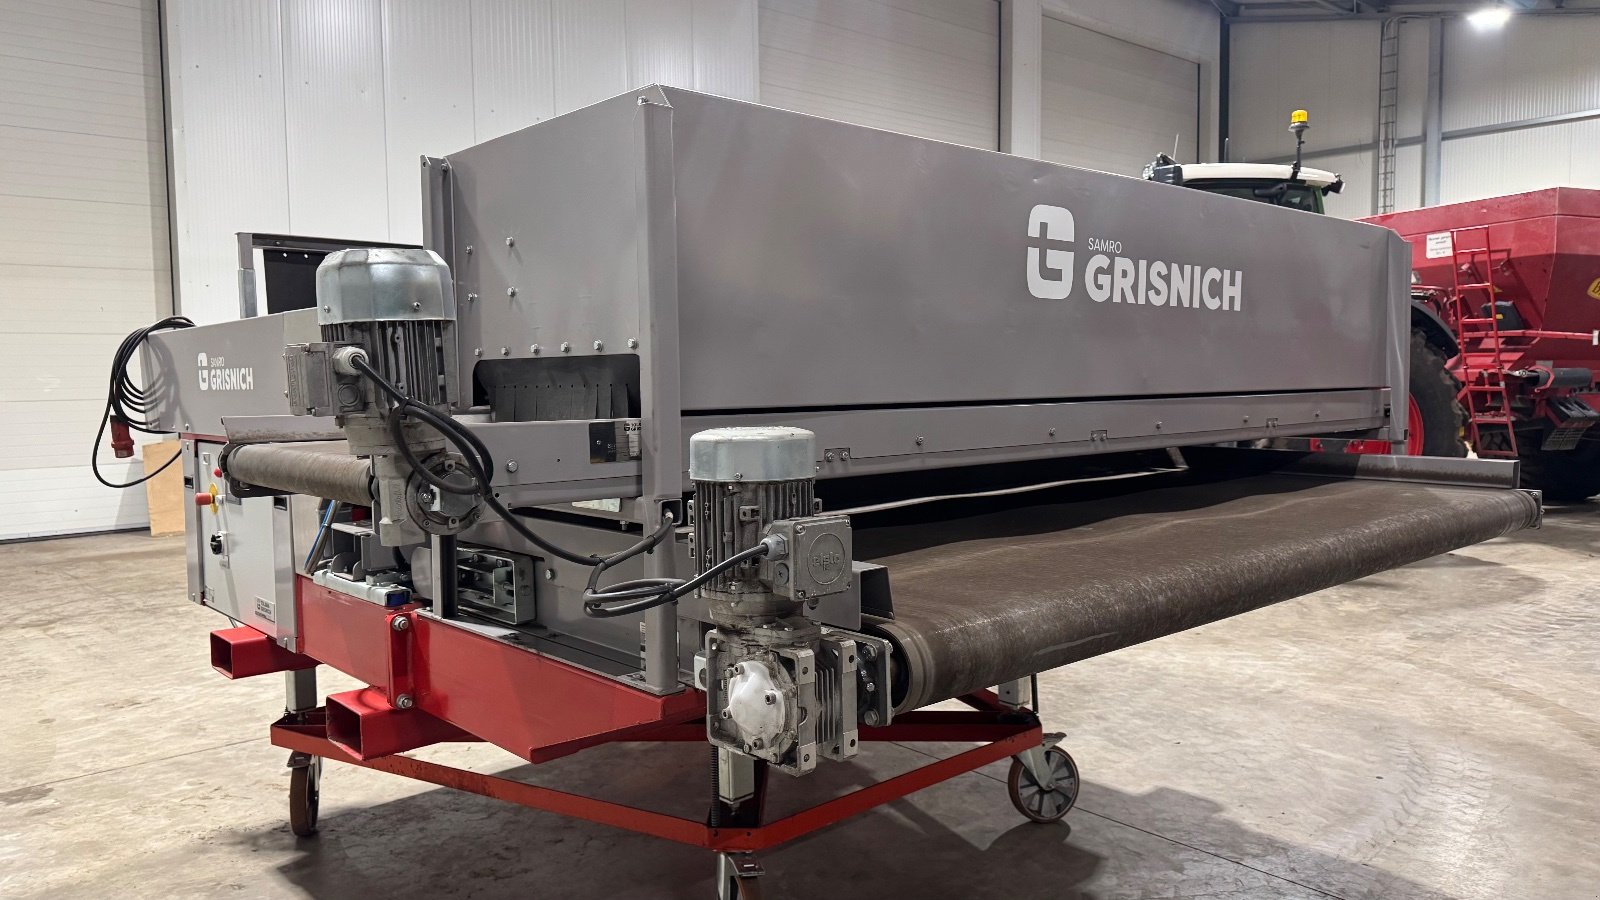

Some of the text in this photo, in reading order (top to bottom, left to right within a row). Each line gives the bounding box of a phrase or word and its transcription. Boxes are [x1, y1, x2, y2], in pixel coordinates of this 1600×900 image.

[1088, 237, 1123, 254] SAMRO
[1084, 254, 1243, 312] GRISNICH
[210, 367, 254, 391] GRISNICH
